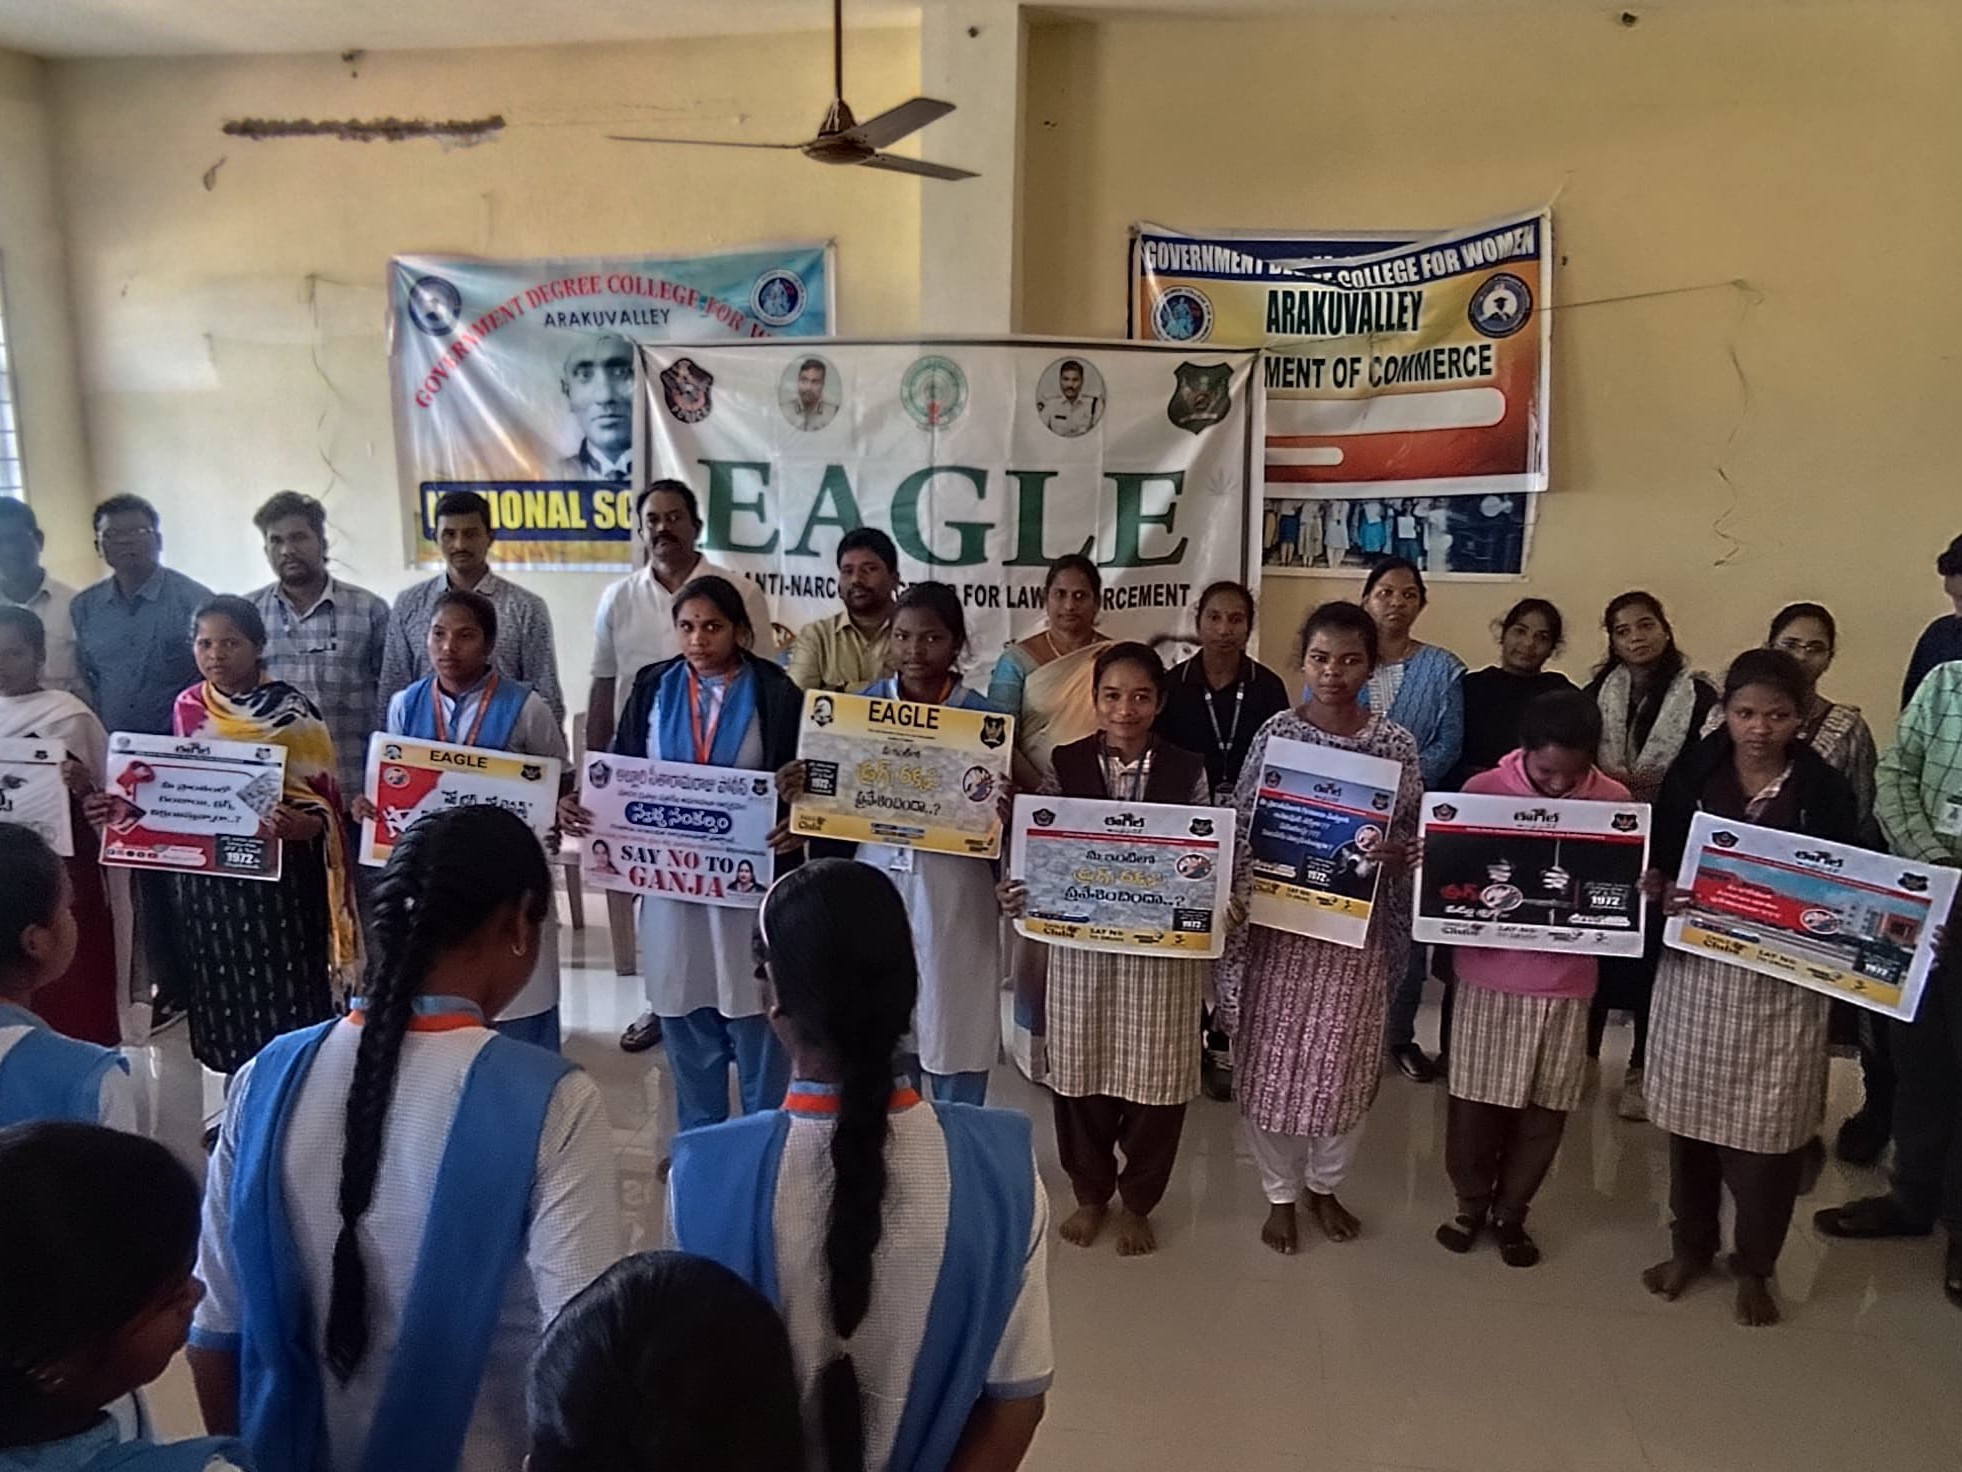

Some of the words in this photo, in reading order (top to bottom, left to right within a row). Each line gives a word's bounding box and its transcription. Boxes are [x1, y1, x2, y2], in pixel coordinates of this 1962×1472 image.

[1338, 257, 1420, 289] COLLEGE
[1420, 249, 1461, 279] FOR
[1460, 225, 1535, 268] WOMEN
[524, 273, 602, 309] DEGREE
[607, 274, 701, 307] COLLEGE
[704, 297, 745, 331] FOR
[1266, 290, 1423, 335] ARAKUVALLEY
[544, 308, 671, 328] ARAKUVALLEY
[1332, 357, 1362, 388] OF
[1368, 344, 1493, 388] COMMERCE
[695, 458, 1190, 568] EAGLE
[963, 584, 1000, 609] FOR
[869, 700, 941, 729] EAGLE
[430, 750, 488, 768] EAGLE
[226, 851, 254, 864] 1972
[621, 845, 661, 865] SAY
[667, 849, 700, 870] NO
[705, 856, 734, 874] TO
[629, 866, 724, 898] GANJA
[1591, 895, 1621, 906] 1972
